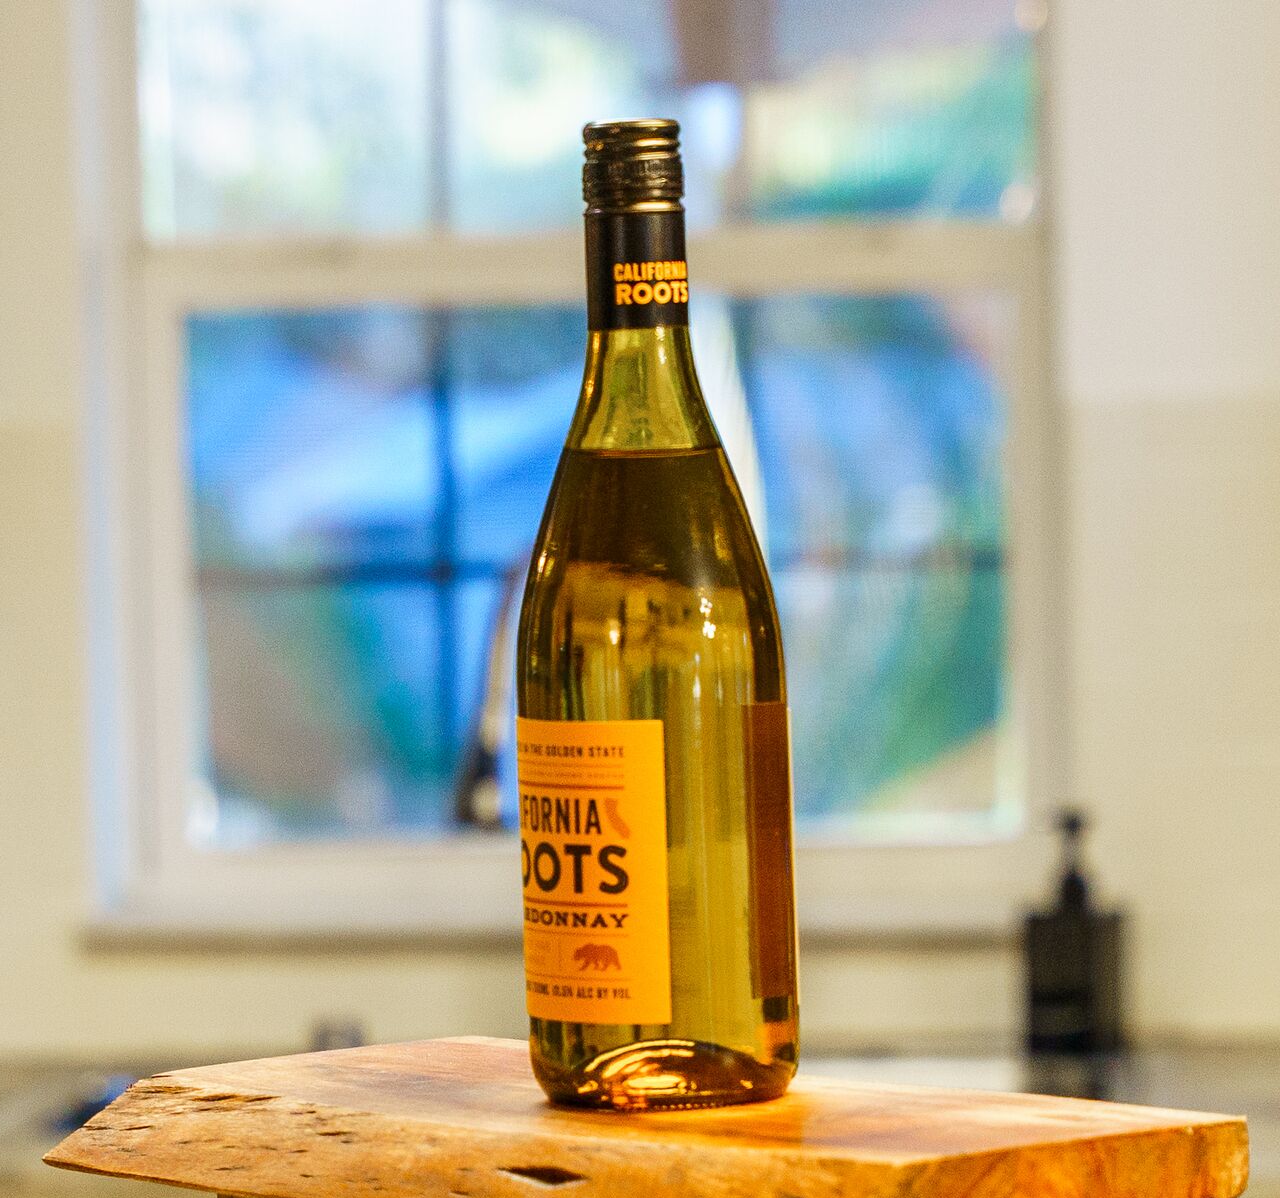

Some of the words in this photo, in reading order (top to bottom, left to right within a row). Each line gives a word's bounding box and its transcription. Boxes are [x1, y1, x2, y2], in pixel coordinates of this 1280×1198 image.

[614, 261, 688, 281] CALIFORNI
[615, 281, 689, 305] ROOTS
[546, 744, 583, 758] GOLDEN
[588, 745, 623, 758] STATE
[519, 794, 602, 835] FORNIA
[597, 987, 608, 1000] BY
